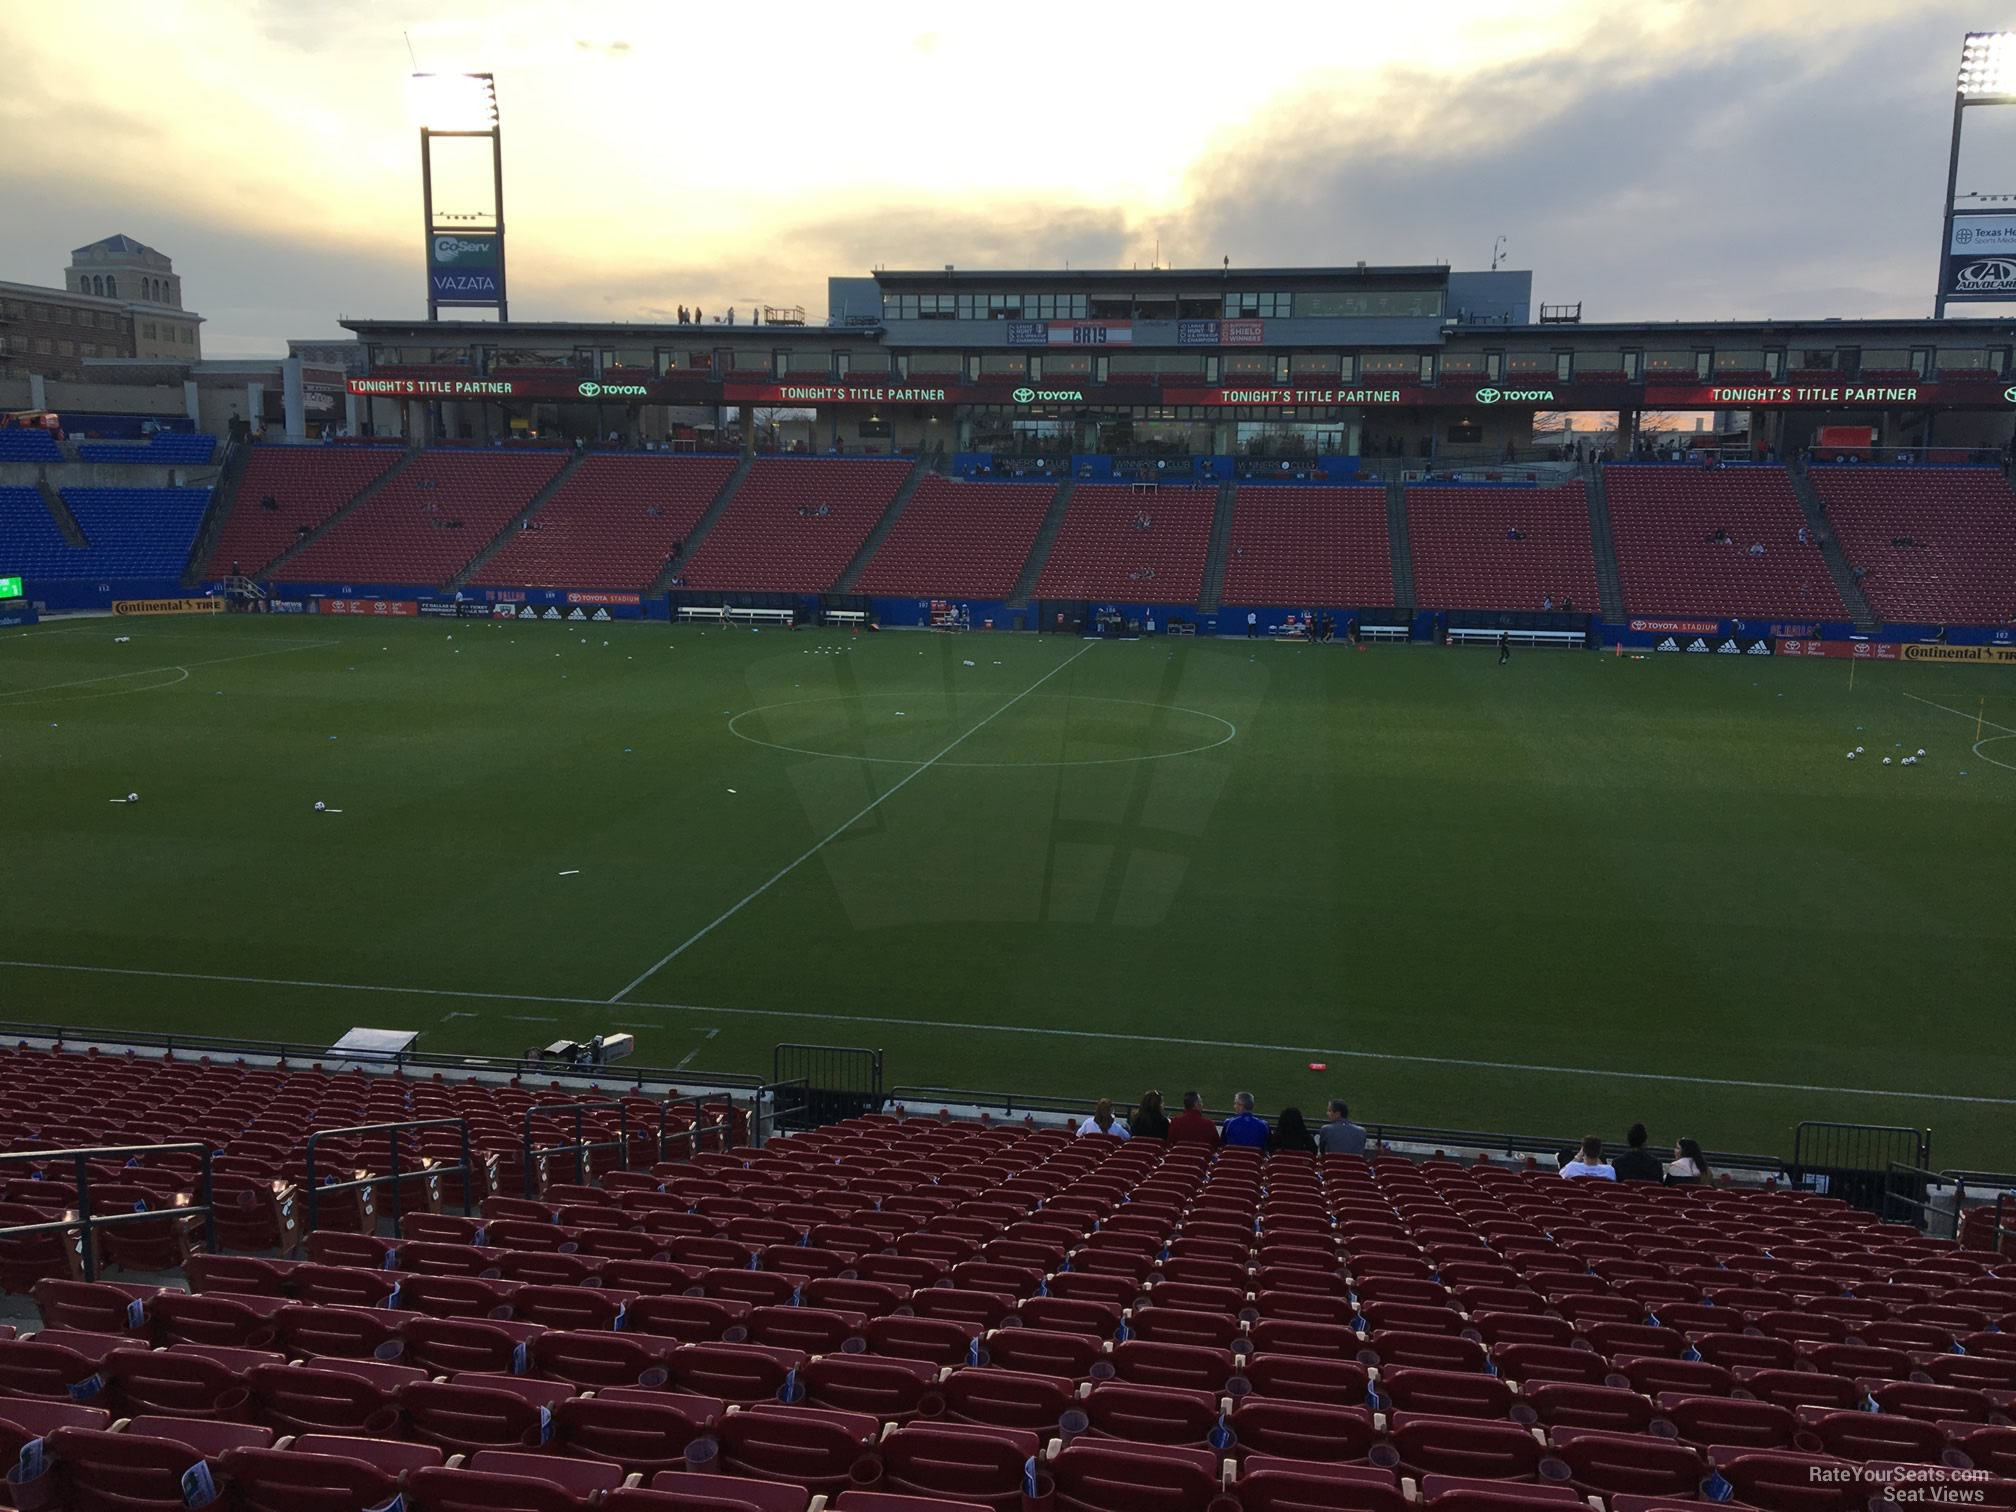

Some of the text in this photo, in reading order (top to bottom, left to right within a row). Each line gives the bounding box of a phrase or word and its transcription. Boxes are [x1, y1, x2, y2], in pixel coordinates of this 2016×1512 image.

[1976, 229, 2002, 237] Texas
[439, 240, 491, 252] CoServ
[433, 276, 495, 290] VAZATA
[1073, 327, 1107, 344] BR19
[350, 380, 512, 394] TONIGHT'S TITLE PARTNER
[603, 385, 648, 395] TOYOTA
[780, 387, 946, 401] TONIGHT'S TITLE PARTNER
[1037, 391, 1083, 401] TOYOTA
[1222, 391, 1401, 403] TONIGHT'S TITLE PARTNER
[1503, 391, 1555, 401] TOYOTA
[1713, 388, 1918, 401] TONIGHT'S TITLE PARTNER
[1045, 458, 1069, 467] CLUB
[1166, 460, 1191, 468] CLUB
[115, 600, 222, 615] Continental TIRE
[1682, 623, 1718, 631] STADIUM
[1905, 645, 1981, 660] Continental
